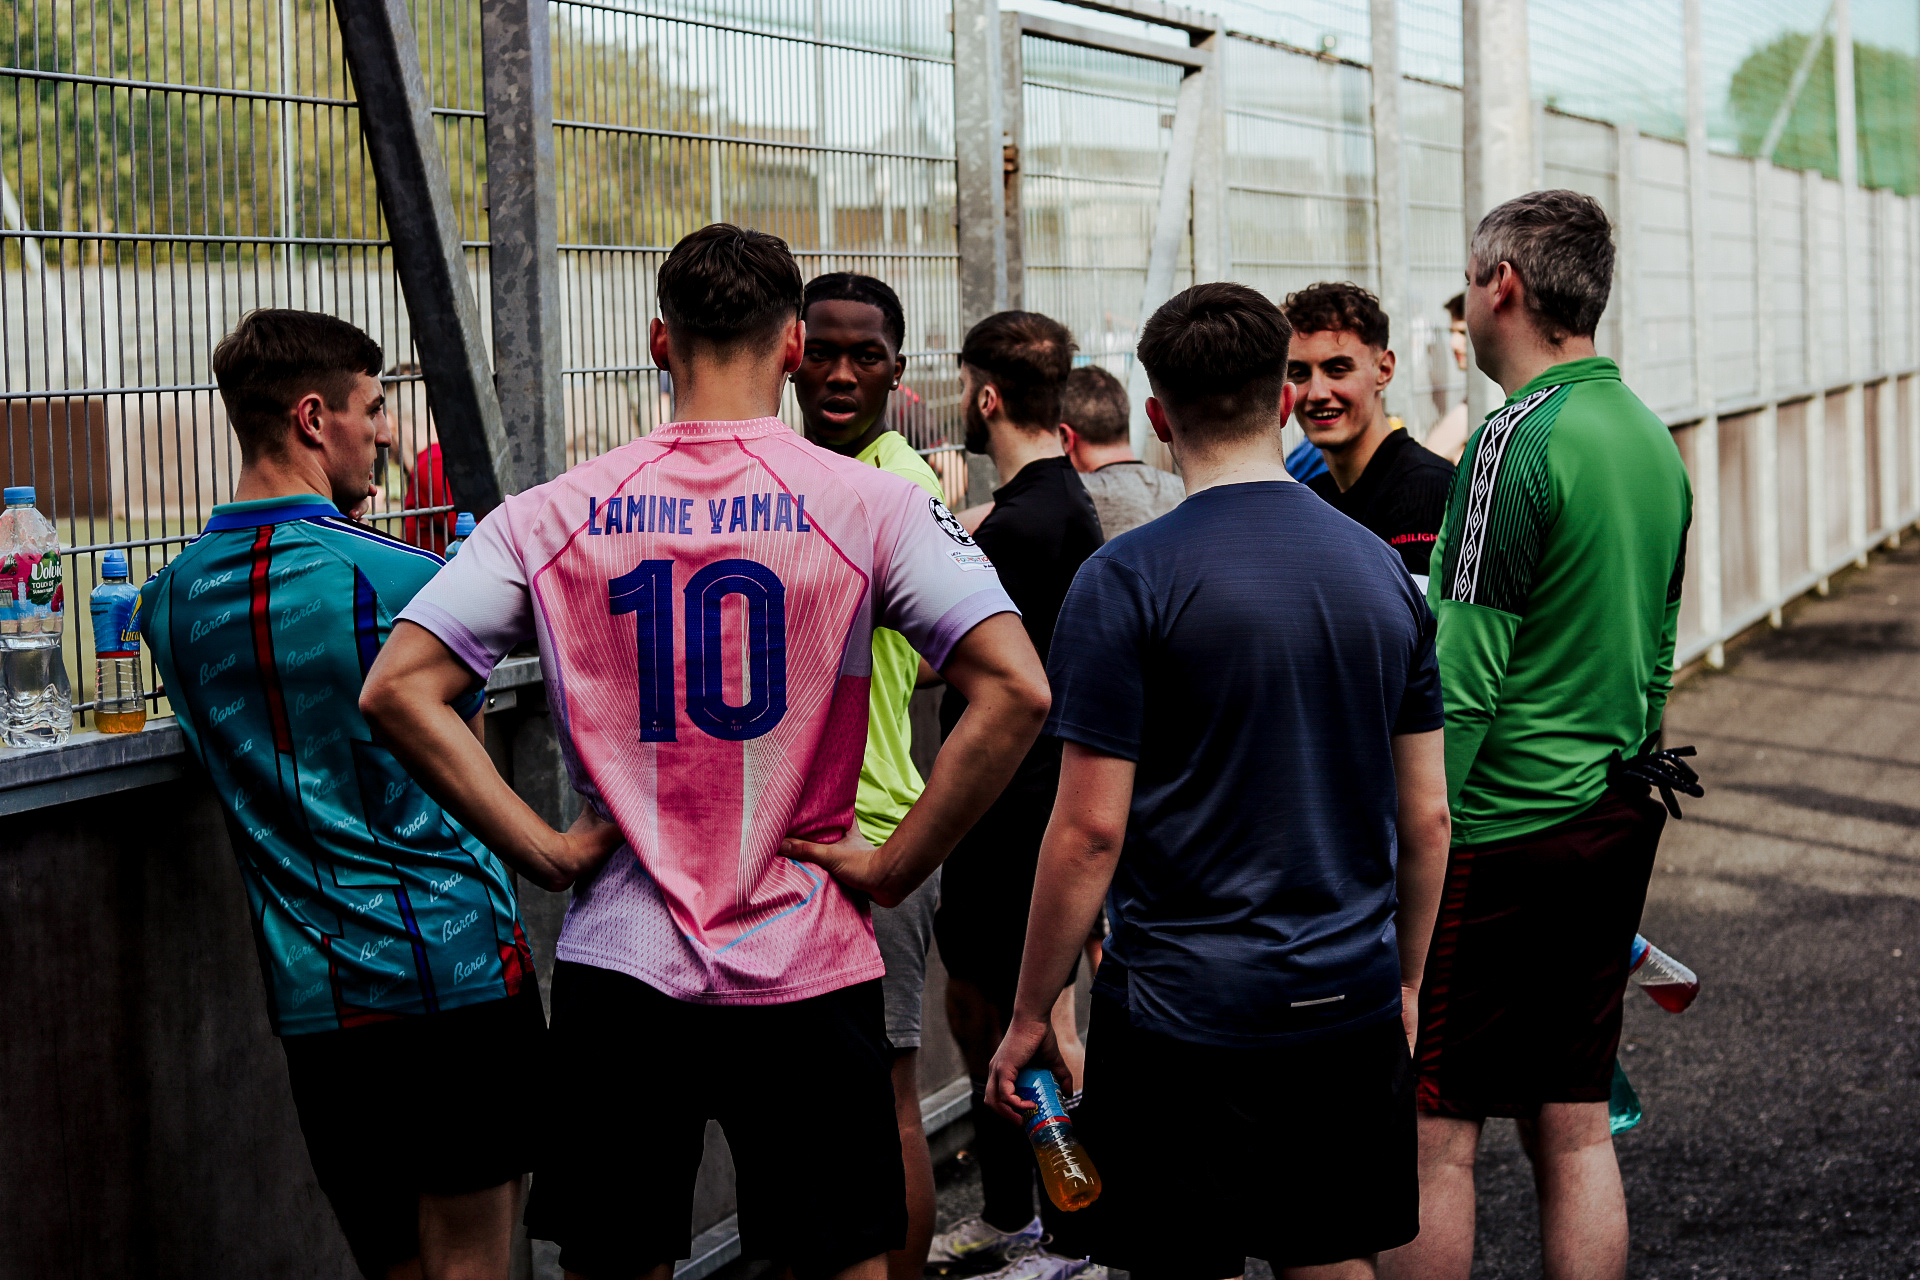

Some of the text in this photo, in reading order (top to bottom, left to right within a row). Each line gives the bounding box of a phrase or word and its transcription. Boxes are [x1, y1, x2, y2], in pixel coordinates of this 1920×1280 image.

[588, 493, 810, 535] LAMINE YAMAL
[1386, 533, 1438, 545] MBILIGH
[188, 571, 232, 600] Barça
[191, 610, 231, 643] Barça
[280, 598, 321, 631] Barça
[286, 642, 326, 674] Barça
[608, 558, 788, 742] 10
[200, 653, 236, 685] Barça
[209, 696, 246, 728] Barça
[429, 872, 464, 902] Barça
[442, 909, 479, 943] Barça
[454, 952, 487, 985] Barça
